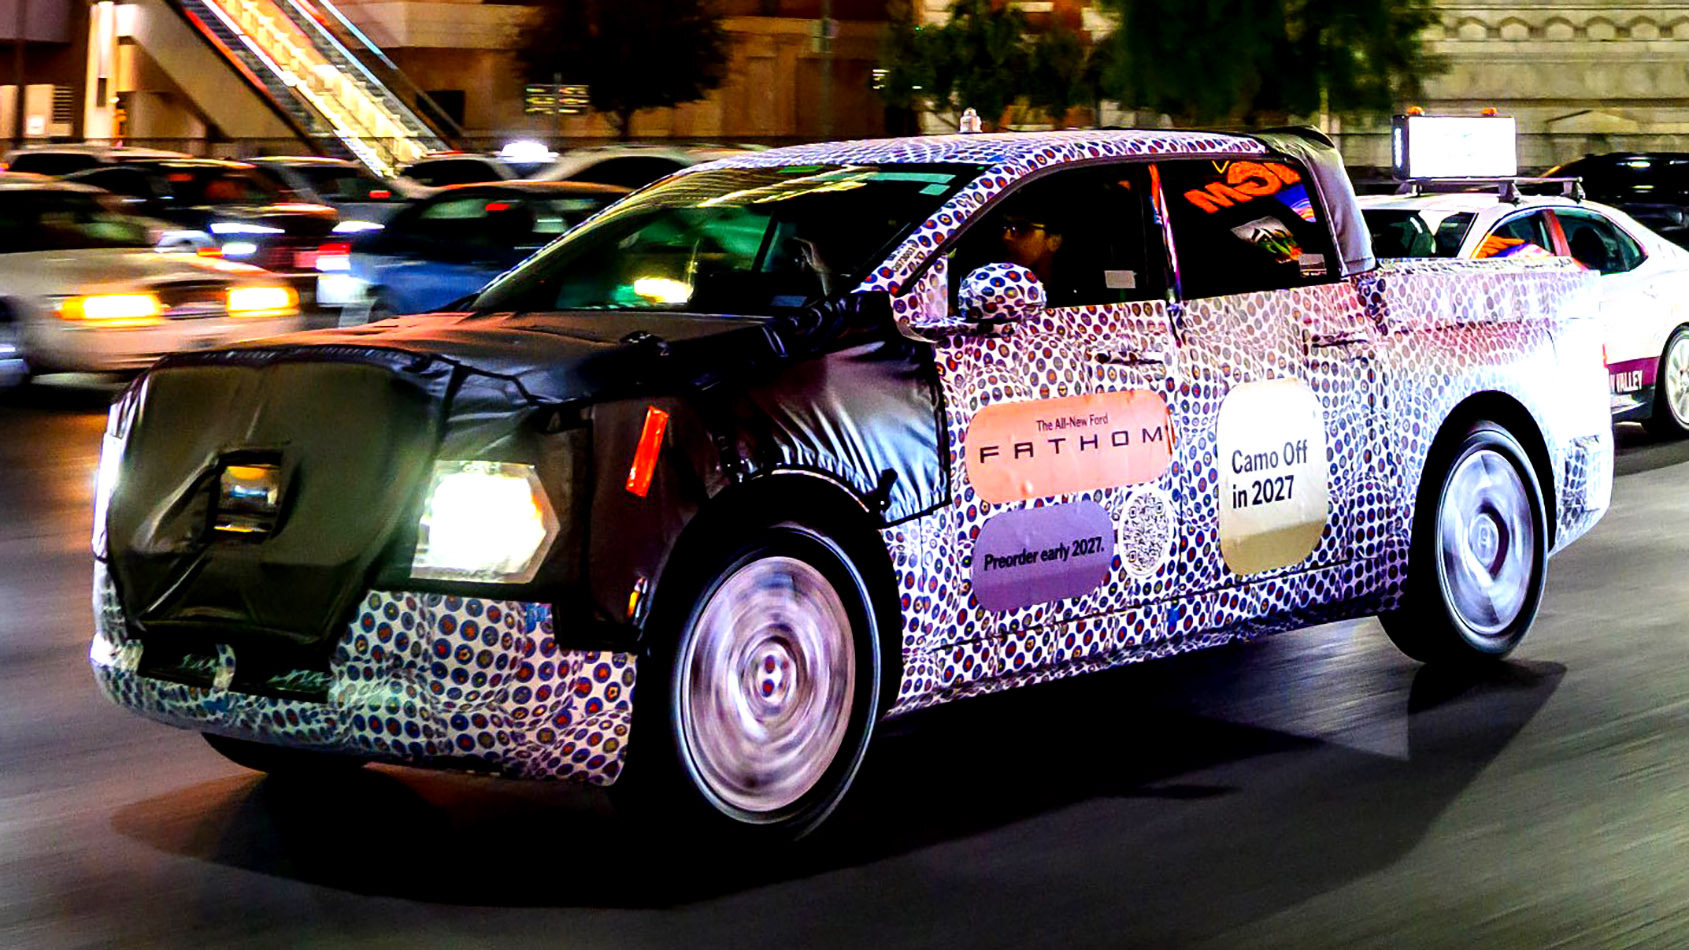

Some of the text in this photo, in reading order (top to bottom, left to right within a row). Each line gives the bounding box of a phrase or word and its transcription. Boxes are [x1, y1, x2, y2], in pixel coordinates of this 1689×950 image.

[1616, 369, 1643, 393] VALLEY
[1036, 413, 1109, 432] The All-New Ford
[979, 426, 1163, 463] FATHOM
[1231, 438, 1308, 474] Camo Off
[1232, 474, 1294, 509] in 2027
[984, 536, 1105, 571] Preorder early 2027.
